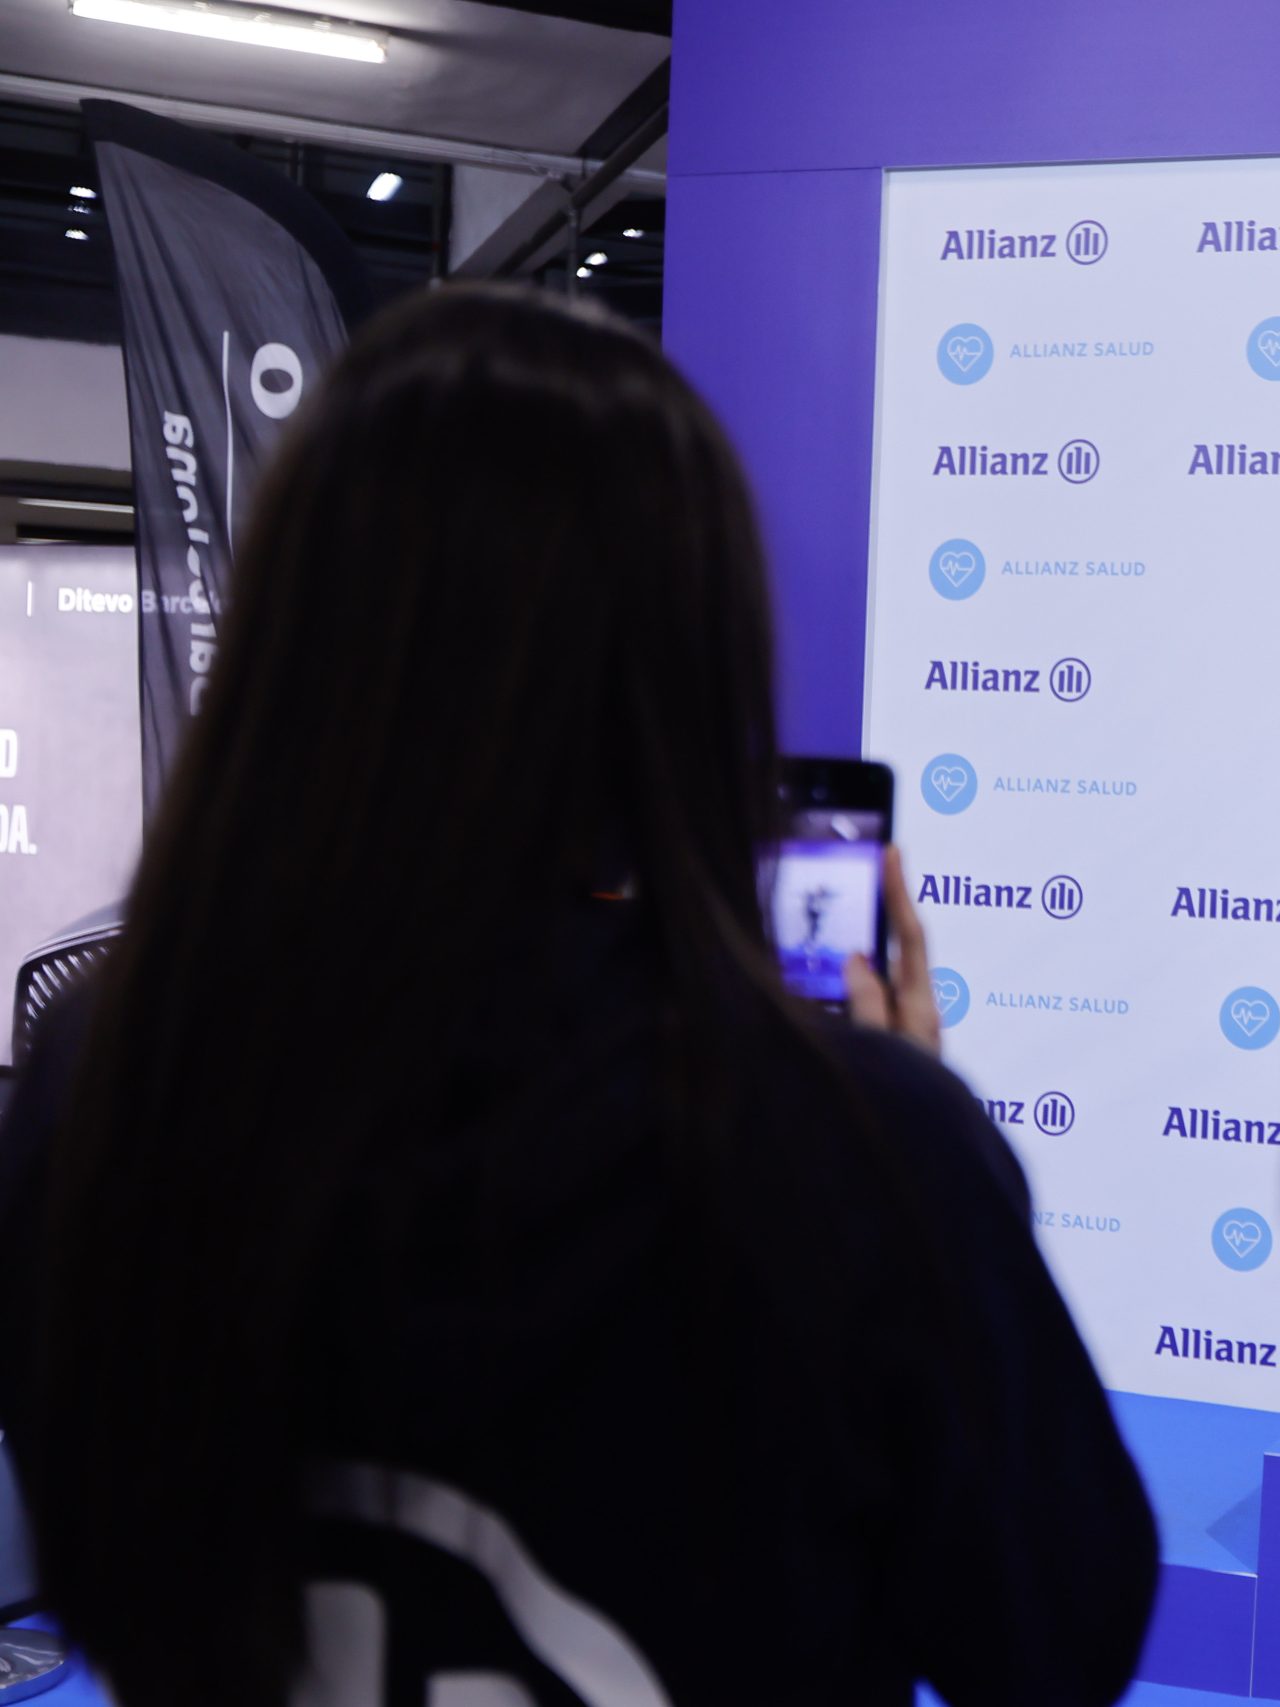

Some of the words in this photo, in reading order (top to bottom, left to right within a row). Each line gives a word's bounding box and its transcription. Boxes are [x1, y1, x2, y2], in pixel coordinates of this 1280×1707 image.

[941, 229, 1056, 260] Allianz
[1010, 342, 1087, 358] ALLIANZ
[1094, 342, 1154, 356] SALUD
[933, 446, 1048, 475] Allianz
[1002, 561, 1079, 575] ALLIANZ
[1086, 561, 1145, 576] SALUD
[58, 587, 133, 613] Ditevo
[925, 661, 1040, 692] Allianz
[994, 777, 1071, 793] ALLIANZ
[1077, 780, 1136, 796] SALUD
[918, 875, 1032, 908] Allianz
[986, 992, 1062, 1010] ALLIANZ
[1069, 997, 1129, 1014] SALUD
[1062, 1213, 1120, 1232] SALUD
[1155, 1326, 1276, 1367] Allianz
